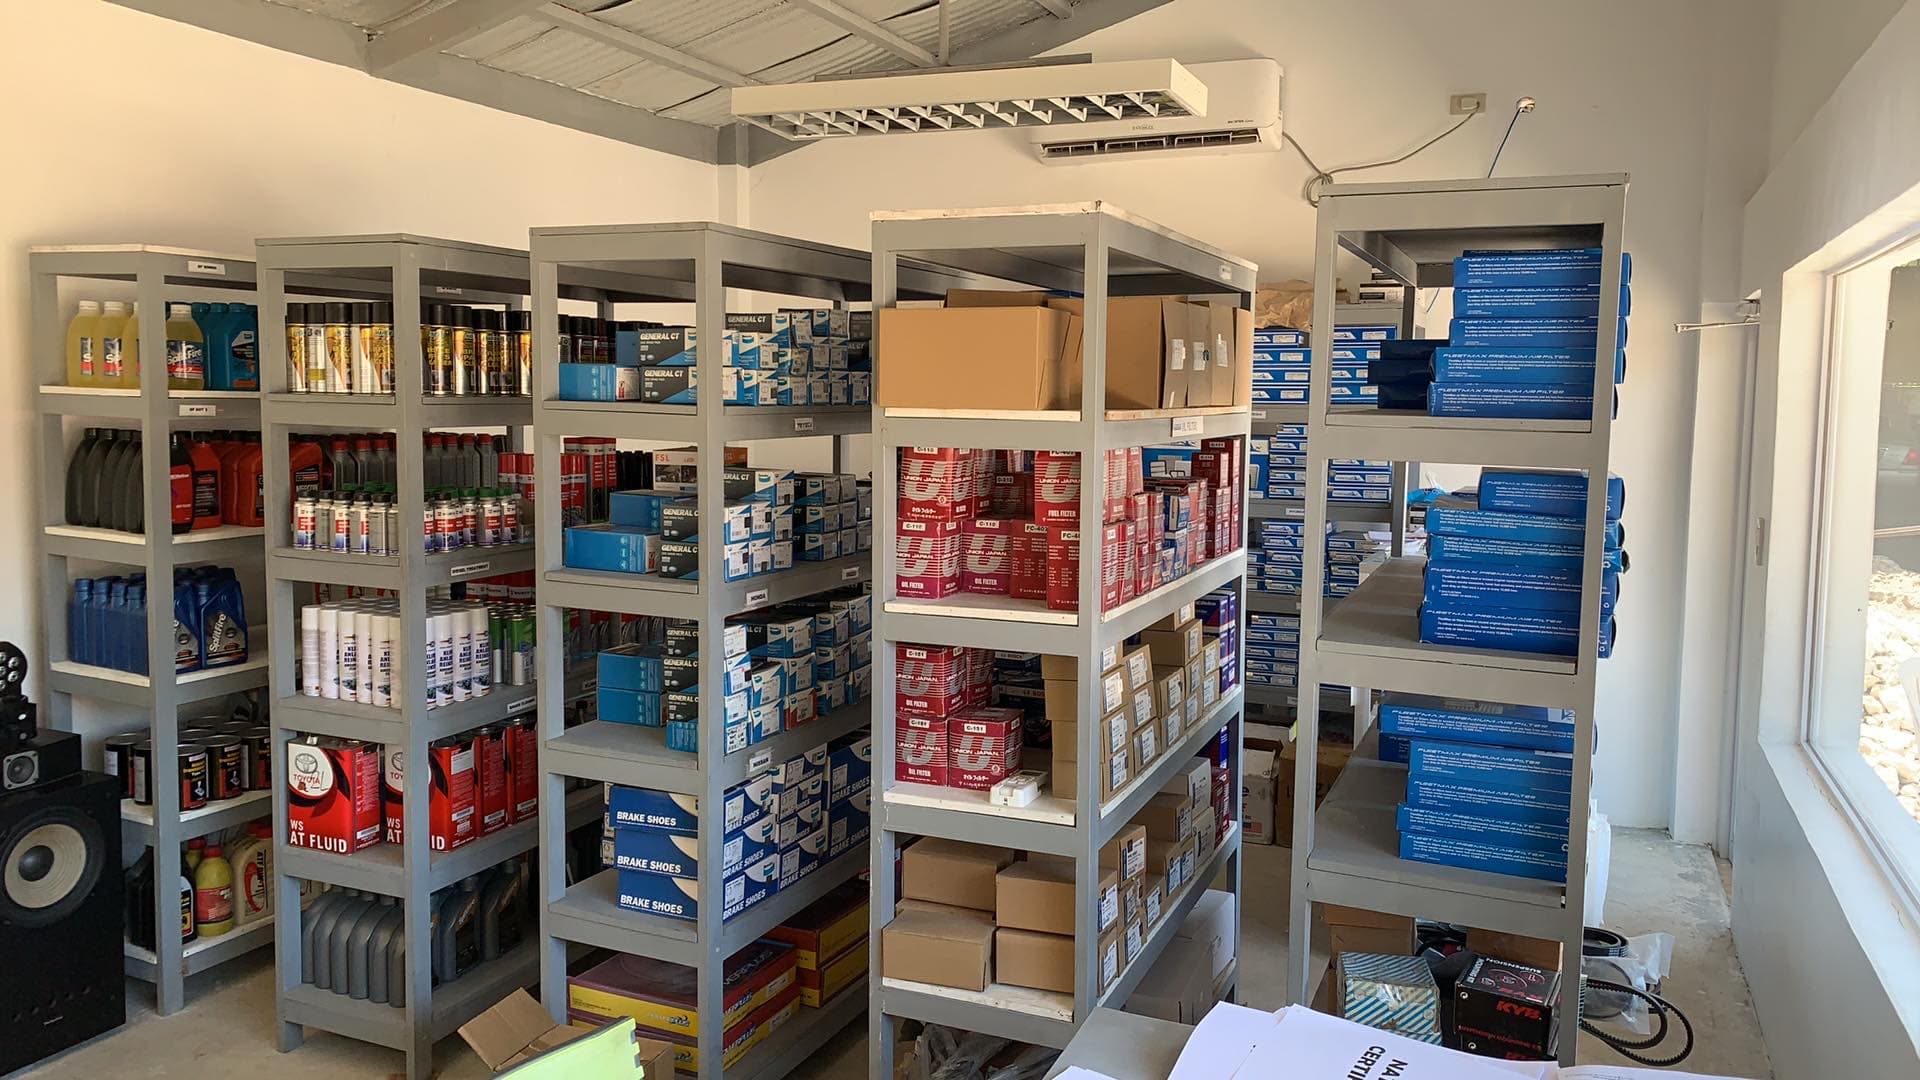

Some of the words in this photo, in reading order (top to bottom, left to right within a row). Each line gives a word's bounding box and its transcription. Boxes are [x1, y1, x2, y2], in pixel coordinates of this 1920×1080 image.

[728, 315, 756, 323] GENERAL
[758, 315, 766, 323] CT
[640, 333, 670, 341] GENERAL
[670, 332, 680, 340] CT
[674, 370, 684, 378] CT
[724, 472, 740, 481] ERAL
[740, 473, 750, 481] CT
[664, 508, 692, 517] GENERAL
[1048, 509, 1058, 517] FUEL
[662, 544, 691, 553] GENERAL
[910, 581, 924, 589] FILTER
[210, 613, 226, 653] SplitFire
[667, 629, 692, 637] GENERAL
[664, 658, 692, 667] GENERAL
[916, 674, 938, 682] JAPAN
[668, 694, 694, 703] GENERAL
[914, 700, 928, 708] FILTER
[390, 772, 404, 780] TOY
[916, 768, 931, 777] FILTER
[294, 773, 320, 785] TOYOTA
[387, 816, 400, 829] WS
[617, 811, 645, 823] BRAKE
[647, 815, 676, 826] SHOES
[290, 819, 304, 831] WS
[386, 828, 402, 843] AT
[290, 831, 304, 846] AT
[310, 834, 347, 853] FLUID
[617, 855, 648, 869] BRAKE
[650, 860, 681, 874] SHOES
[723, 861, 743, 879] BRAKE
[745, 849, 764, 865] SHOES
[780, 872, 799, 889] BRAKE
[800, 860, 818, 877] SHOES
[620, 894, 650, 908] BRAKE
[652, 900, 682, 914] SHOES
[723, 902, 744, 920] BRAKE
[746, 889, 766, 907] SHOES
[1486, 957, 1542, 974] SUSPENSION
[1496, 1000, 1541, 1020] KYB
